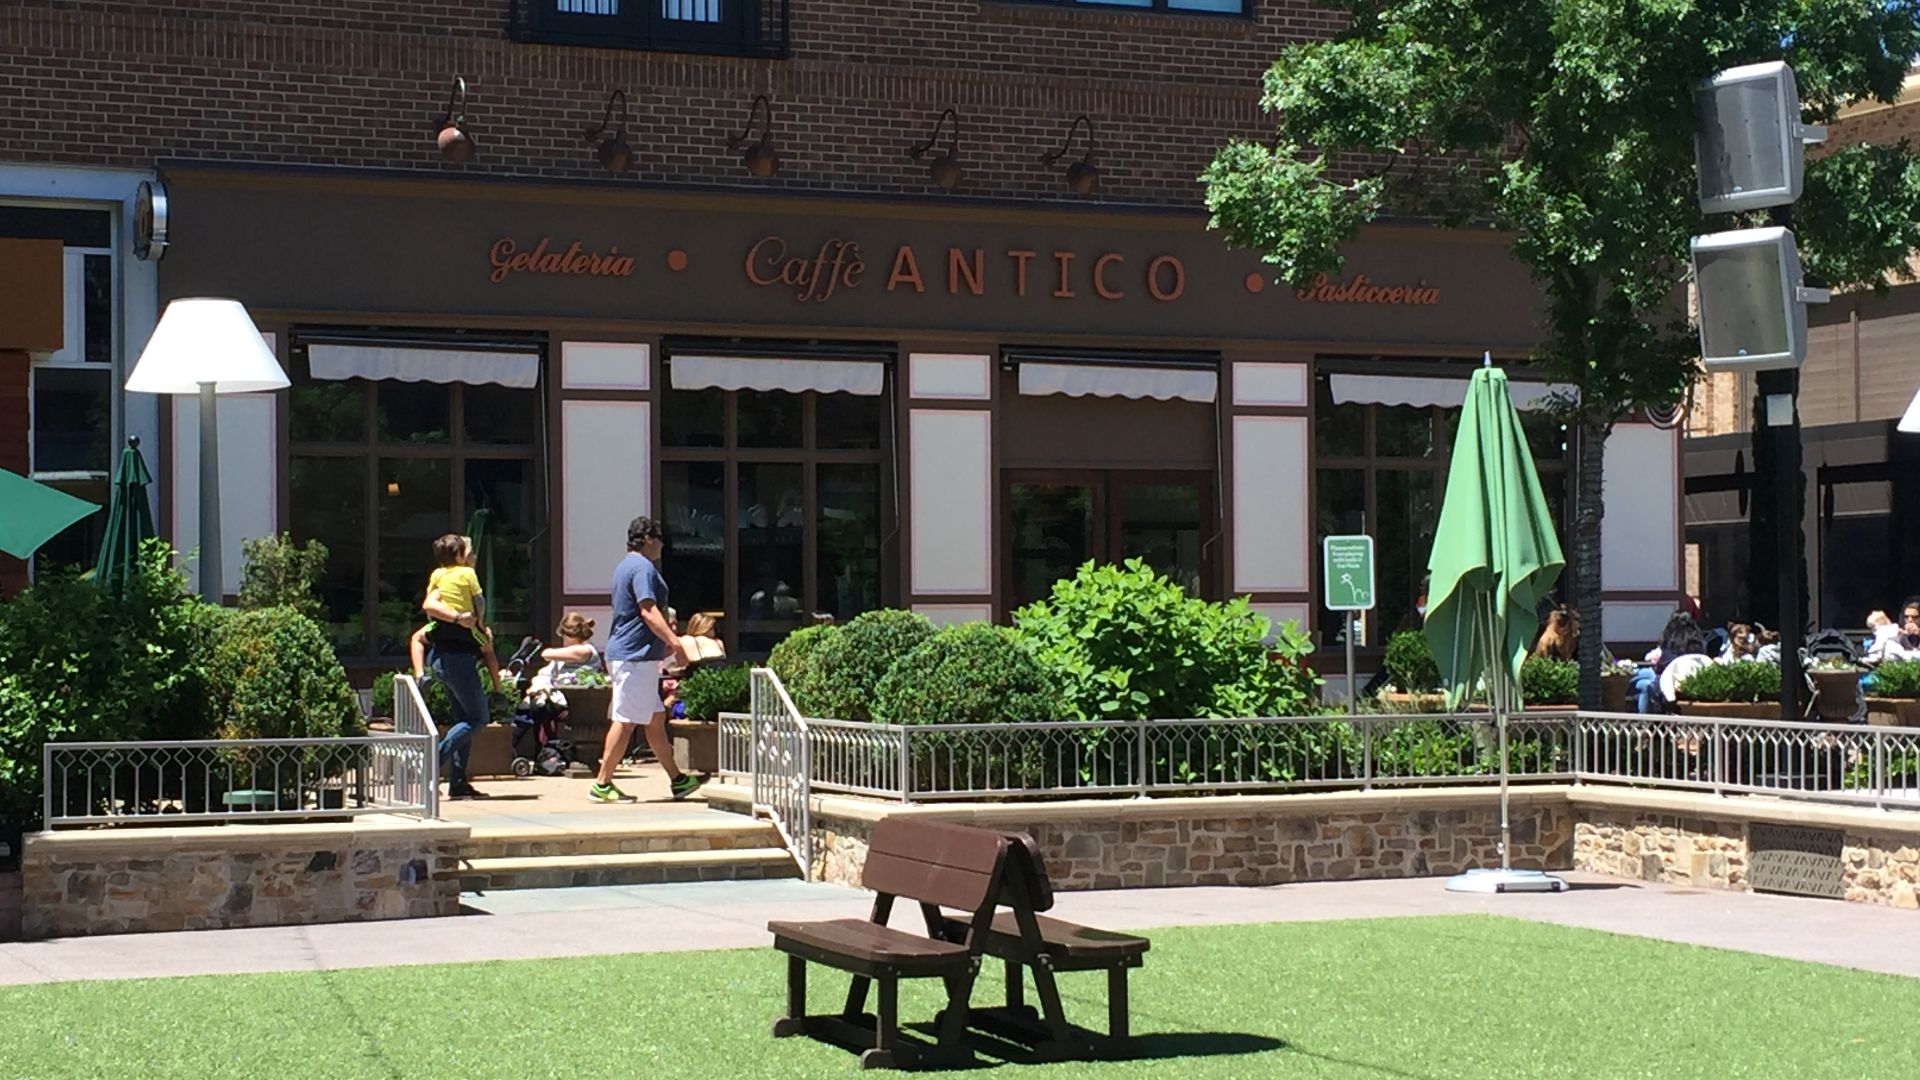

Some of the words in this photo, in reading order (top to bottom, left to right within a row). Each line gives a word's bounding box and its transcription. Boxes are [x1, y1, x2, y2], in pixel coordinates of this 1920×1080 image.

[490, 237, 636, 283] Gelateria
[745, 236, 865, 301] Caffè
[887, 245, 1185, 301] ANTICO
